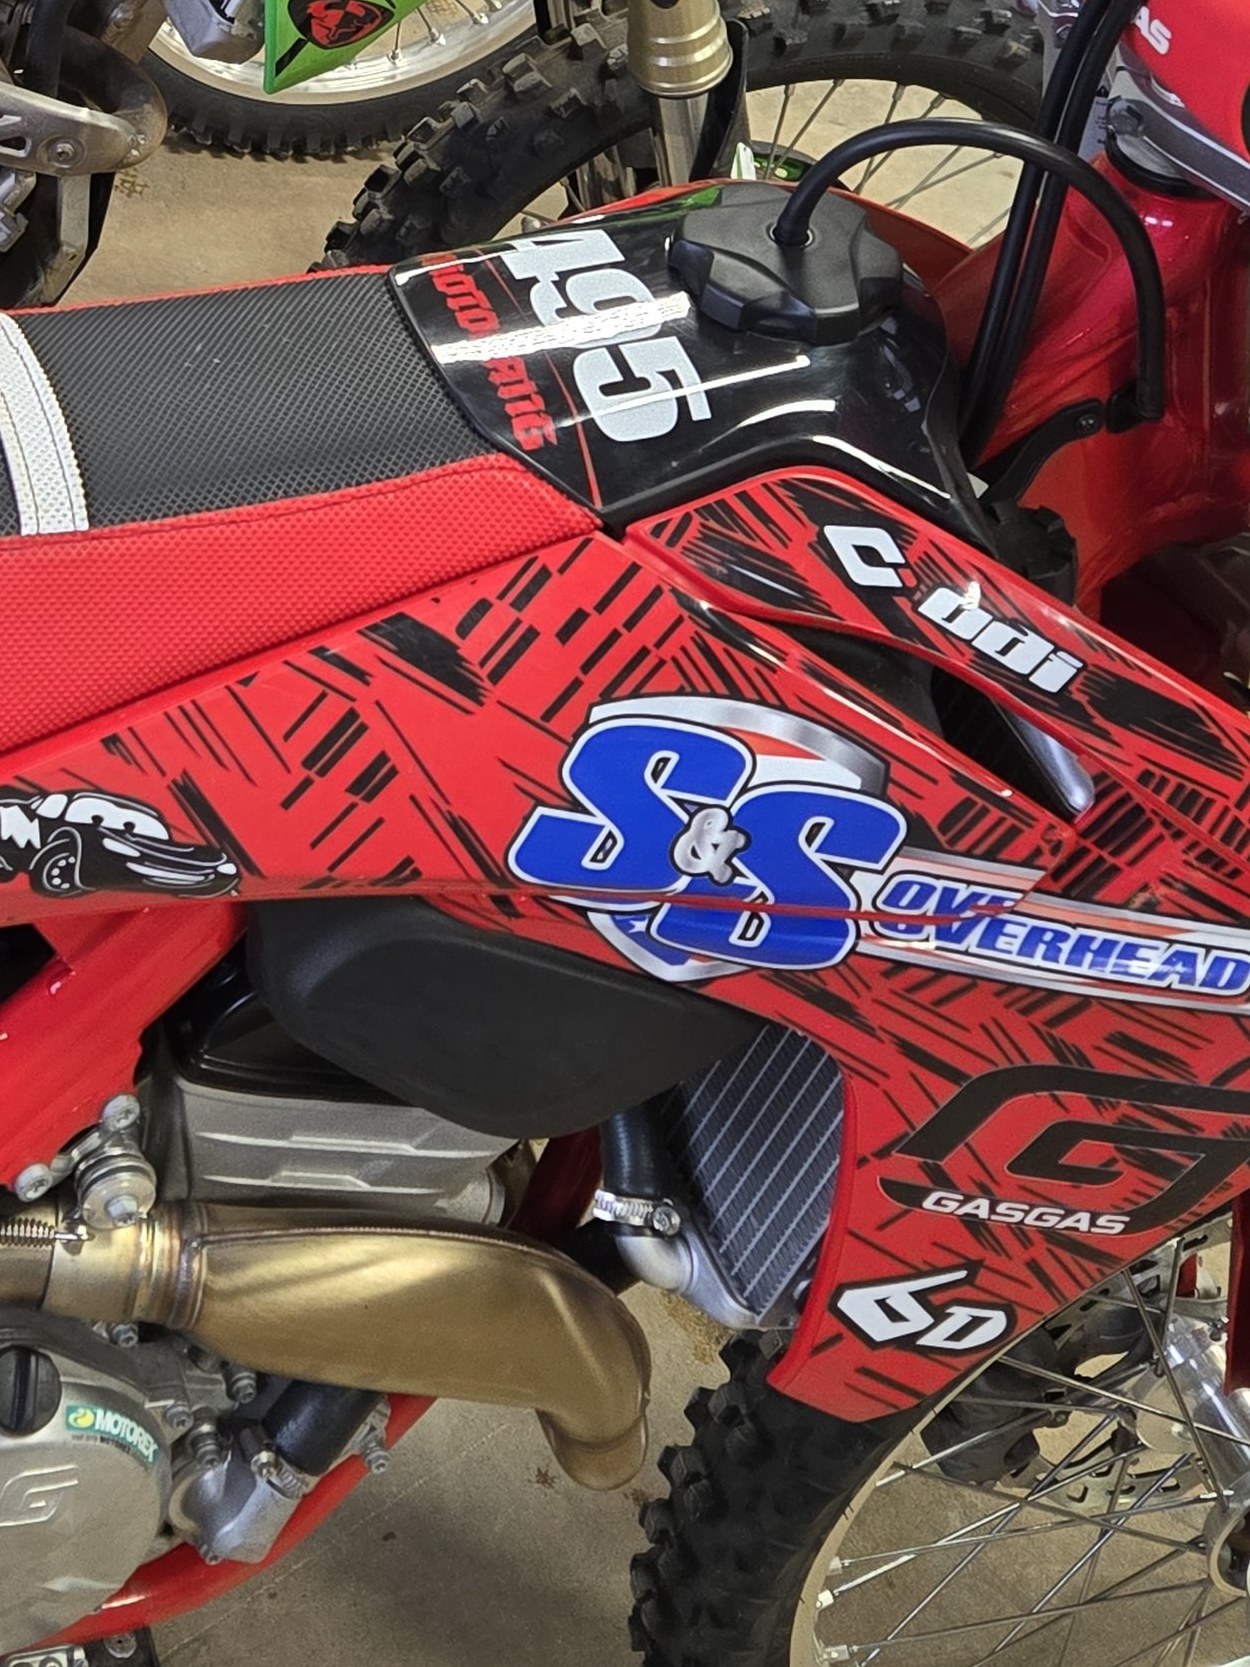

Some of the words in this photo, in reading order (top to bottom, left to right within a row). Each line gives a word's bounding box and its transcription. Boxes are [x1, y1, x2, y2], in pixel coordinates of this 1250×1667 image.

[501, 228, 713, 443] 495
[918, 583, 1085, 694] odi
[507, 718, 909, 972] S&S
[876, 879, 1250, 997] OVERHEAD
[921, 1190, 1130, 1237] GASGAS
[837, 1268, 1010, 1351] 6D
[94, 1408, 159, 1463] MOTOREX
